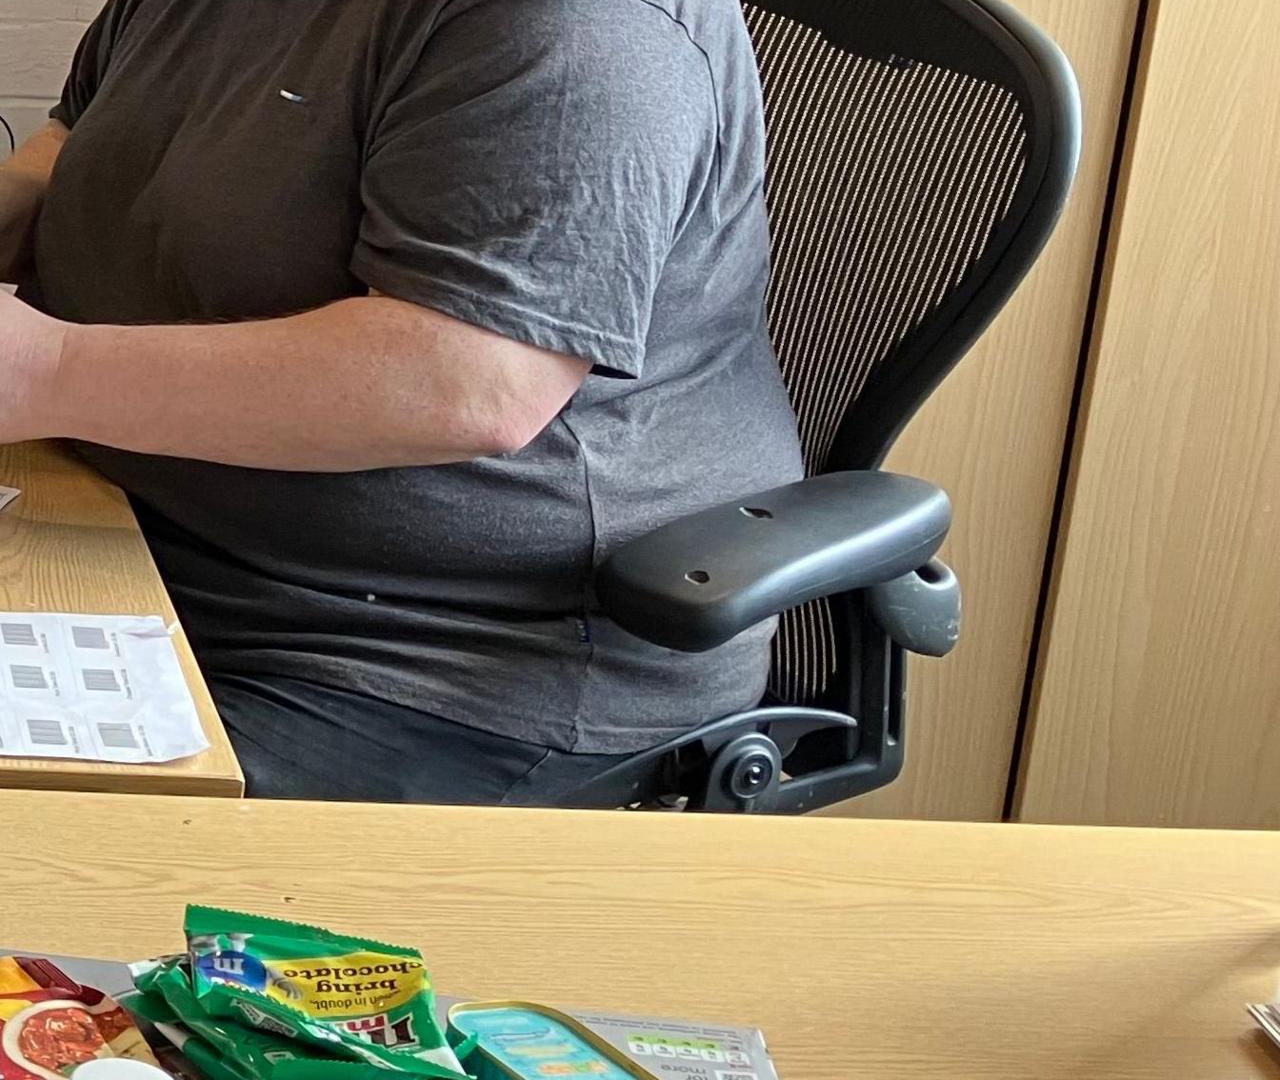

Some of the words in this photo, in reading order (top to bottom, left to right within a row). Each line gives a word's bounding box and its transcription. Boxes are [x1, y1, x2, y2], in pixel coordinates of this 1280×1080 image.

[213, 957, 244, 975] m
[283, 961, 423, 981] chocolate
[316, 978, 398, 994] bring
[354, 997, 367, 1007] in
[661, 1063, 707, 1073] more
